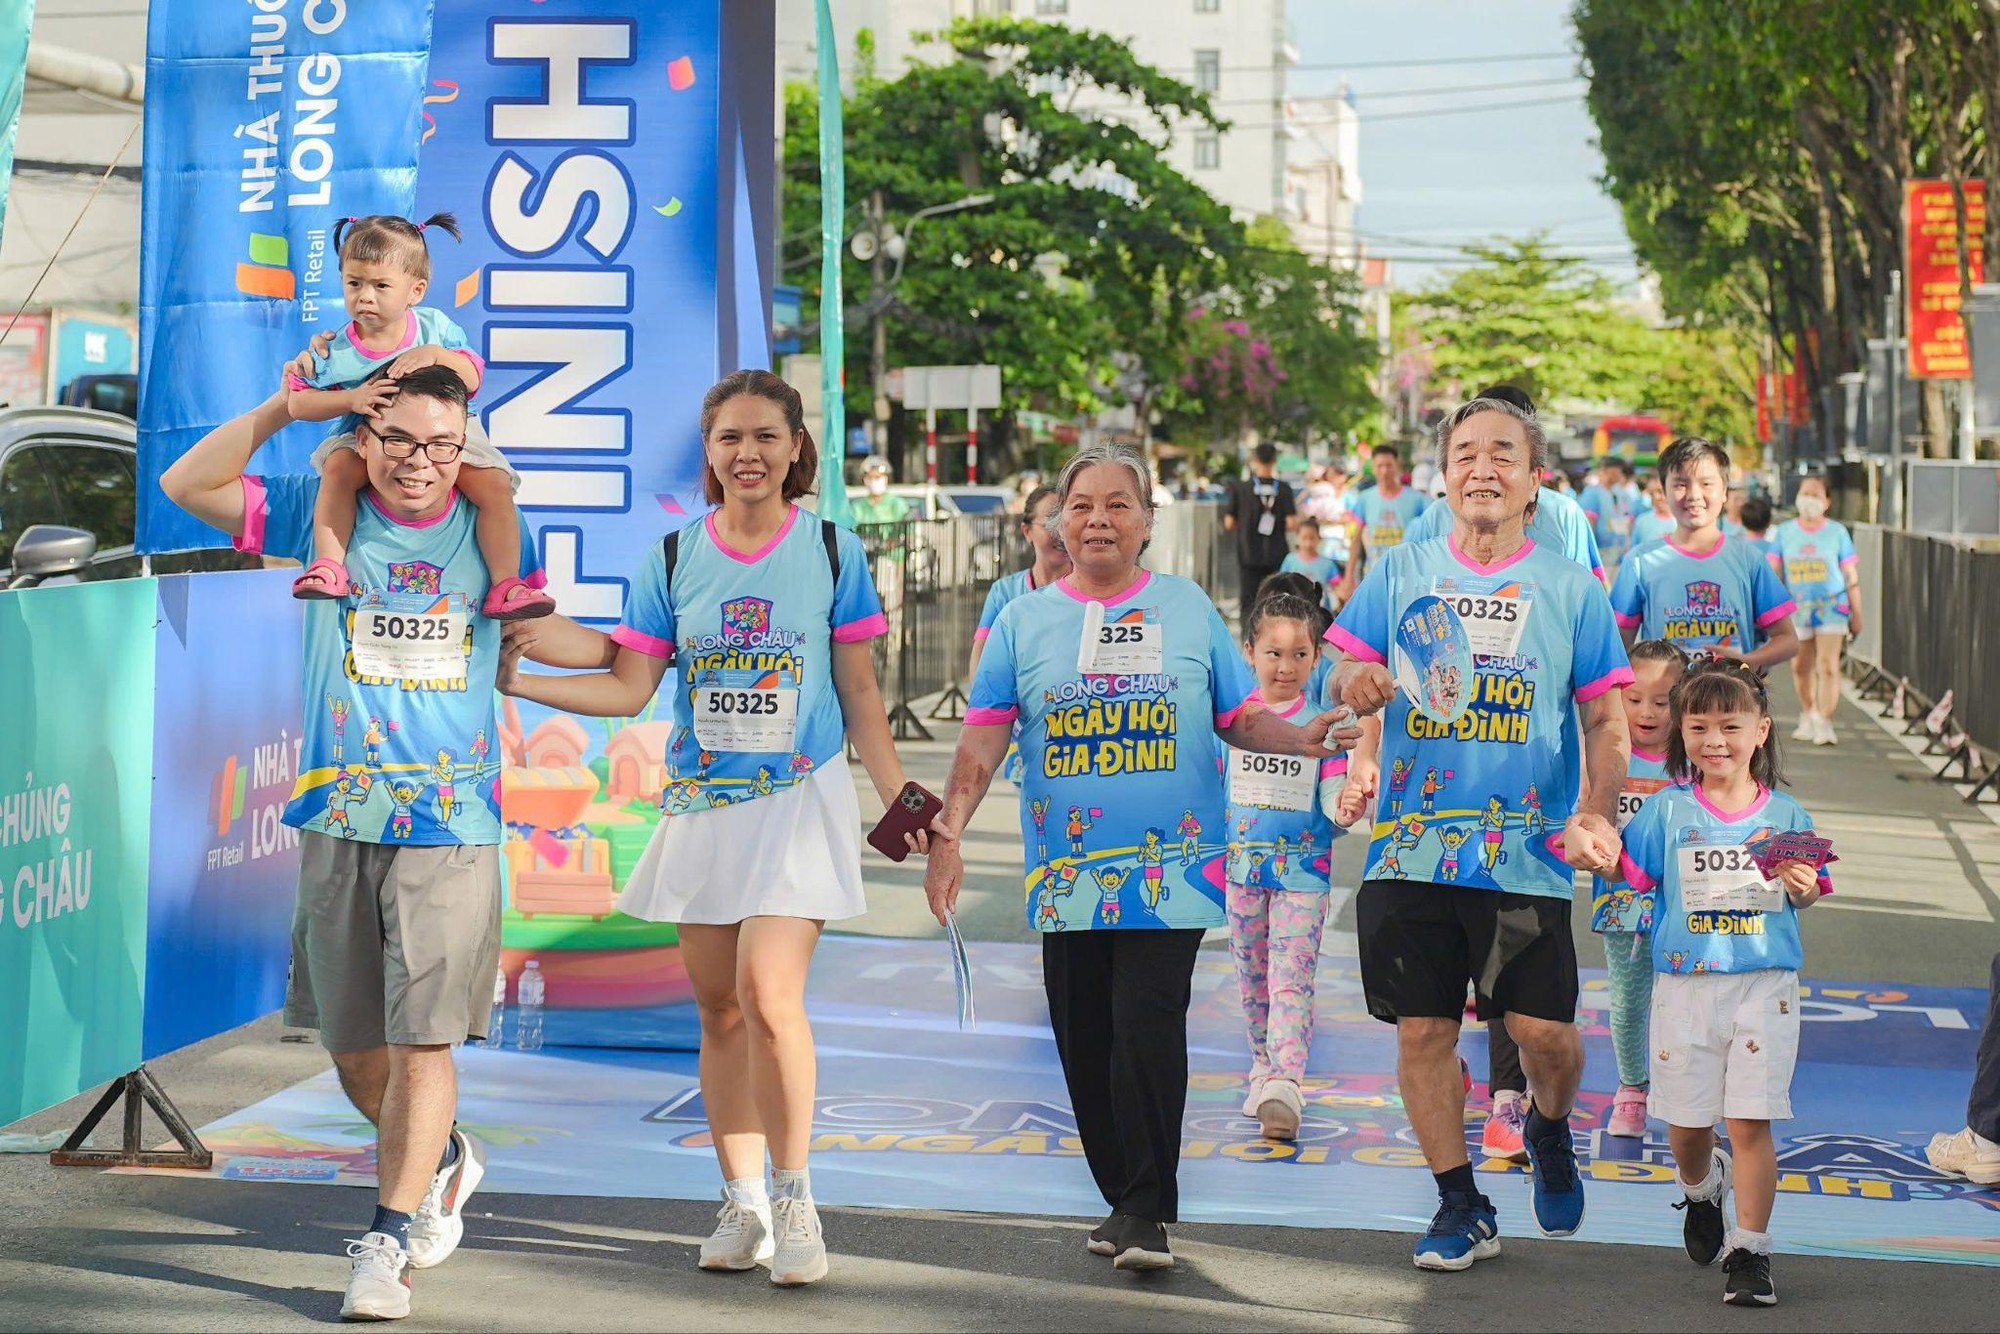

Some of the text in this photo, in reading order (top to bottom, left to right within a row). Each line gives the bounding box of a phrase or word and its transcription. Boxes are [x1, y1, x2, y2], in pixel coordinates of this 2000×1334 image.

[287, 52, 342, 207] LONG
[233, 110, 280, 213] NHÀ
[302, 229, 326, 322] FPT Retail
[486, 18, 634, 622] FINISH
[371, 614, 449, 640] 50325
[694, 627, 796, 652] LONG CHÂU
[707, 691, 779, 715] 50325
[1051, 677, 1110, 704] LONG
[1045, 697, 1124, 740] NGÀY
[253, 728, 290, 790] NHÀ
[1093, 736, 1176, 777] ĐÌNH
[1241, 754, 1302, 778] 50519
[0, 771, 71, 848] HỦNG
[251, 801, 301, 860] LON
[207, 840, 245, 872] FPT Retail
[13, 837, 93, 929] CHÂU
